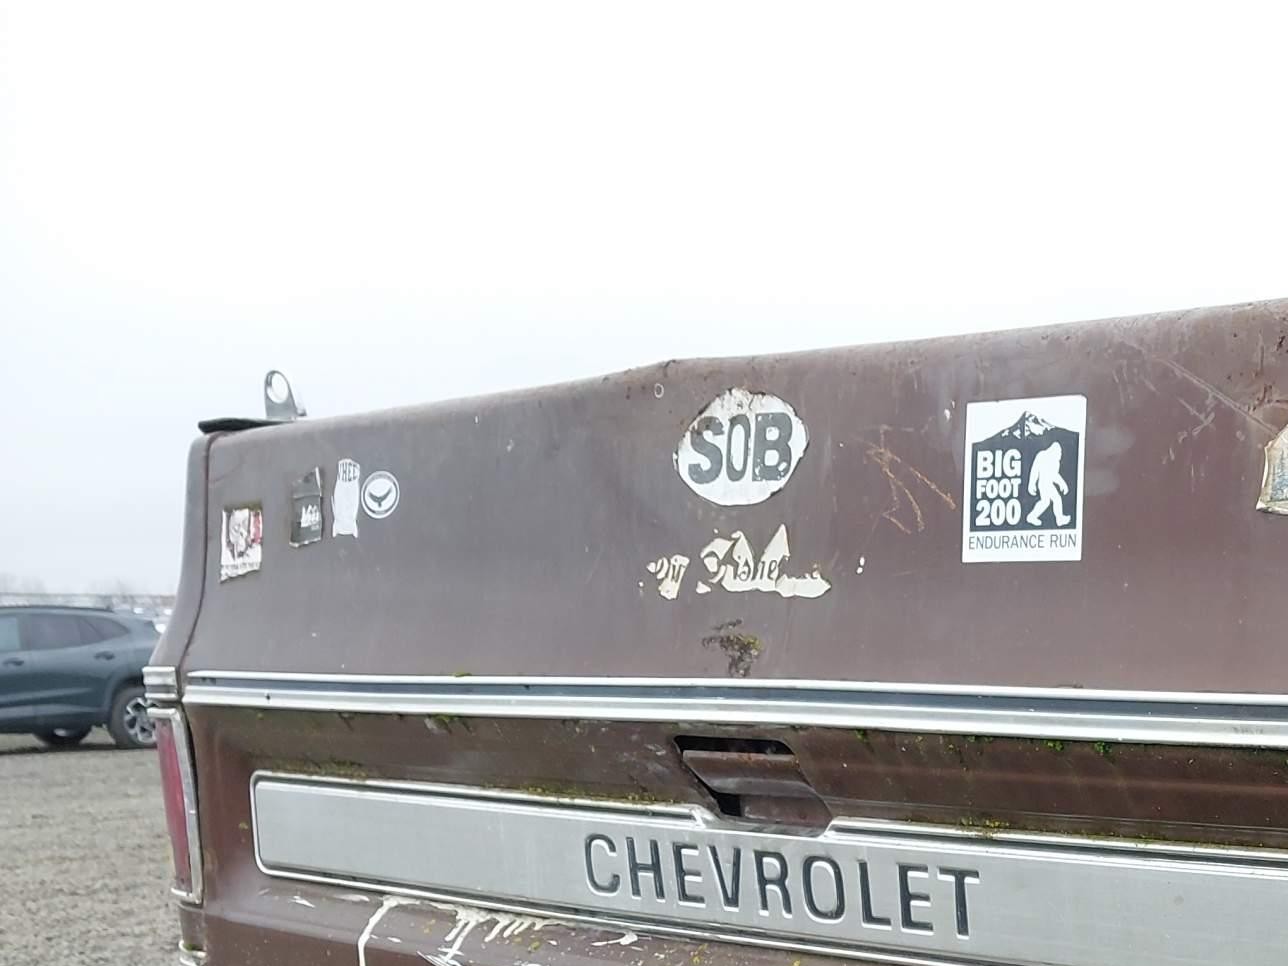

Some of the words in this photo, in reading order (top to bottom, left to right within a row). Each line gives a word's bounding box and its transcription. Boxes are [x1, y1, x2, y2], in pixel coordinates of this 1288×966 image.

[687, 412, 794, 485] SOB
[976, 448, 1022, 479] BIG
[976, 478, 1022, 499] FOOT
[975, 498, 1022, 526] 200
[969, 534, 1045, 550] ENDURANCE
[1049, 533, 1077, 549] RUN
[584, 832, 981, 941] CHEVROLET
